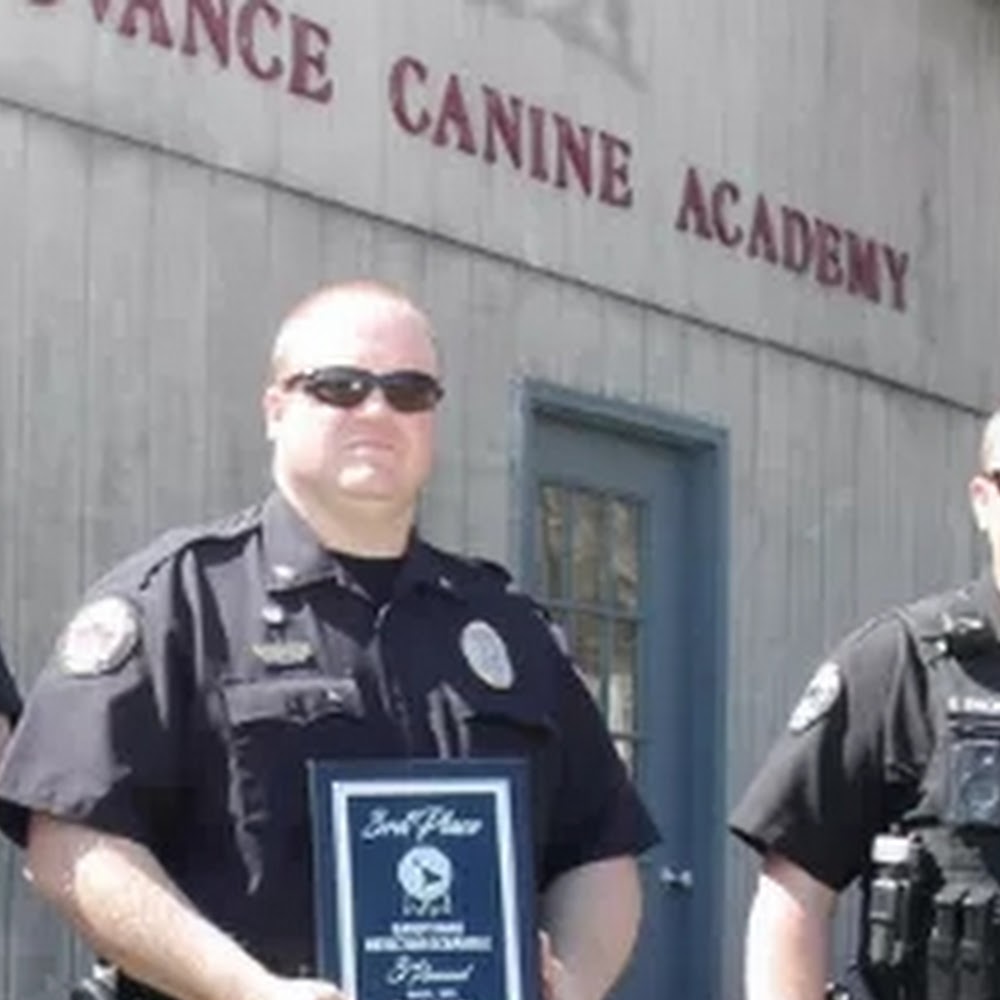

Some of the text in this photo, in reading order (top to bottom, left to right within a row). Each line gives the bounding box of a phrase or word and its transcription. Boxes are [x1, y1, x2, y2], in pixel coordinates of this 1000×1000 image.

[27, 0, 911, 312] ANCE CANINE ACADEMY
